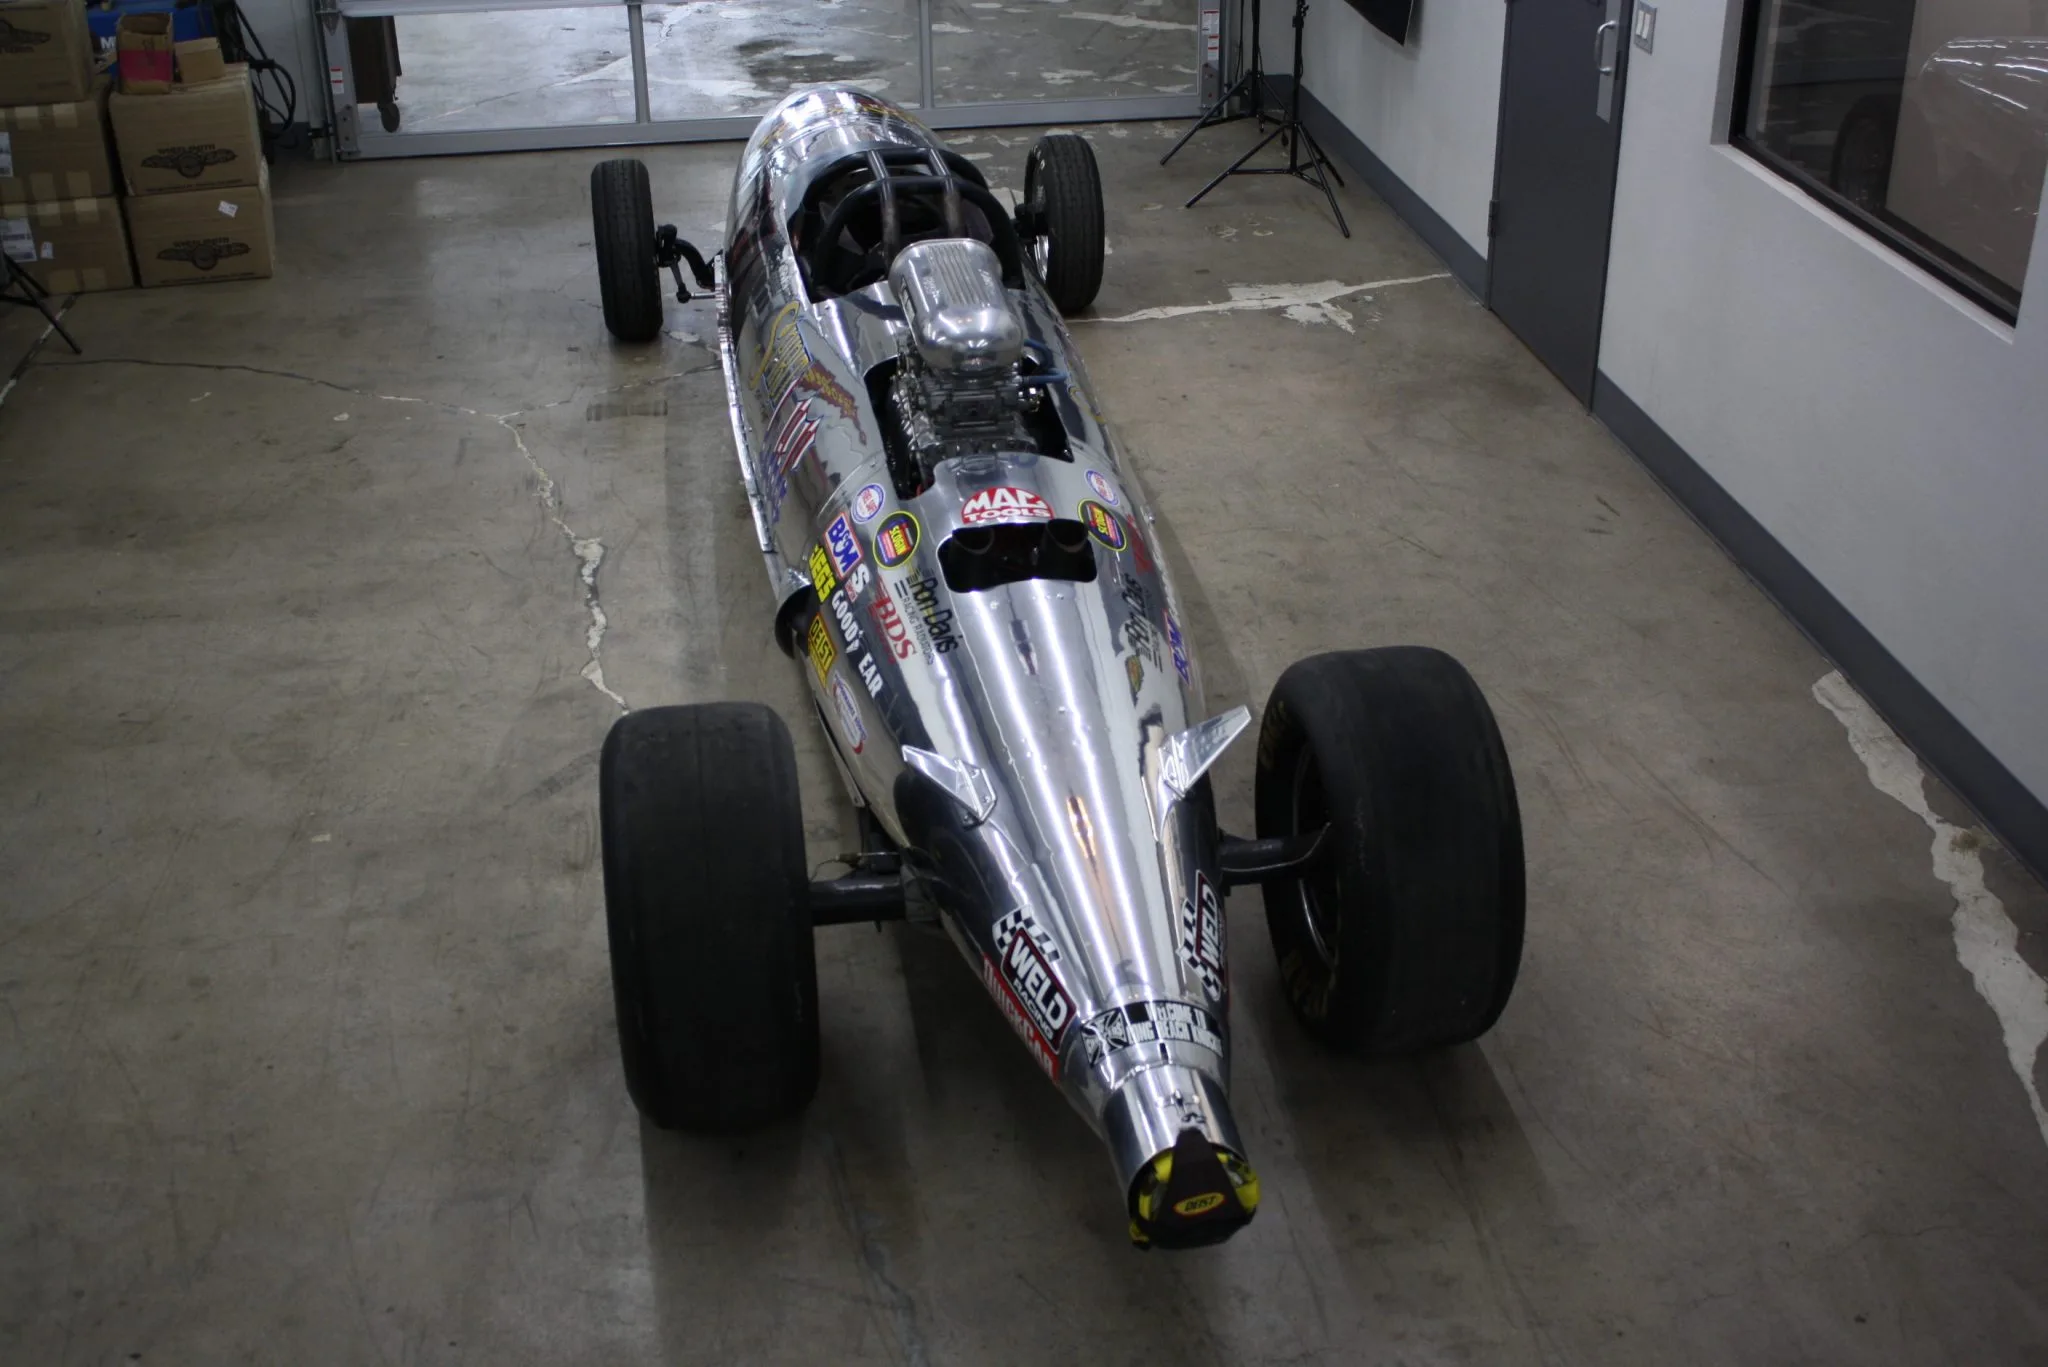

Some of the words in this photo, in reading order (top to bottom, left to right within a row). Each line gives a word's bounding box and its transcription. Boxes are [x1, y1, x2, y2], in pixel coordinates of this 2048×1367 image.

[963, 487, 1049, 514] MAC
[964, 507, 1051, 522] TOOLS
[827, 516, 860, 574] B&M
[902, 597, 918, 625] RACING
[912, 577, 939, 611] Ron
[809, 618, 833, 672] DEIST
[876, 595, 917, 660] BDS
[922, 609, 961, 654] Davis
[1200, 883, 1219, 970] WELD
[1010, 936, 1068, 1031] WELD
[1013, 978, 1055, 1041] RACING
